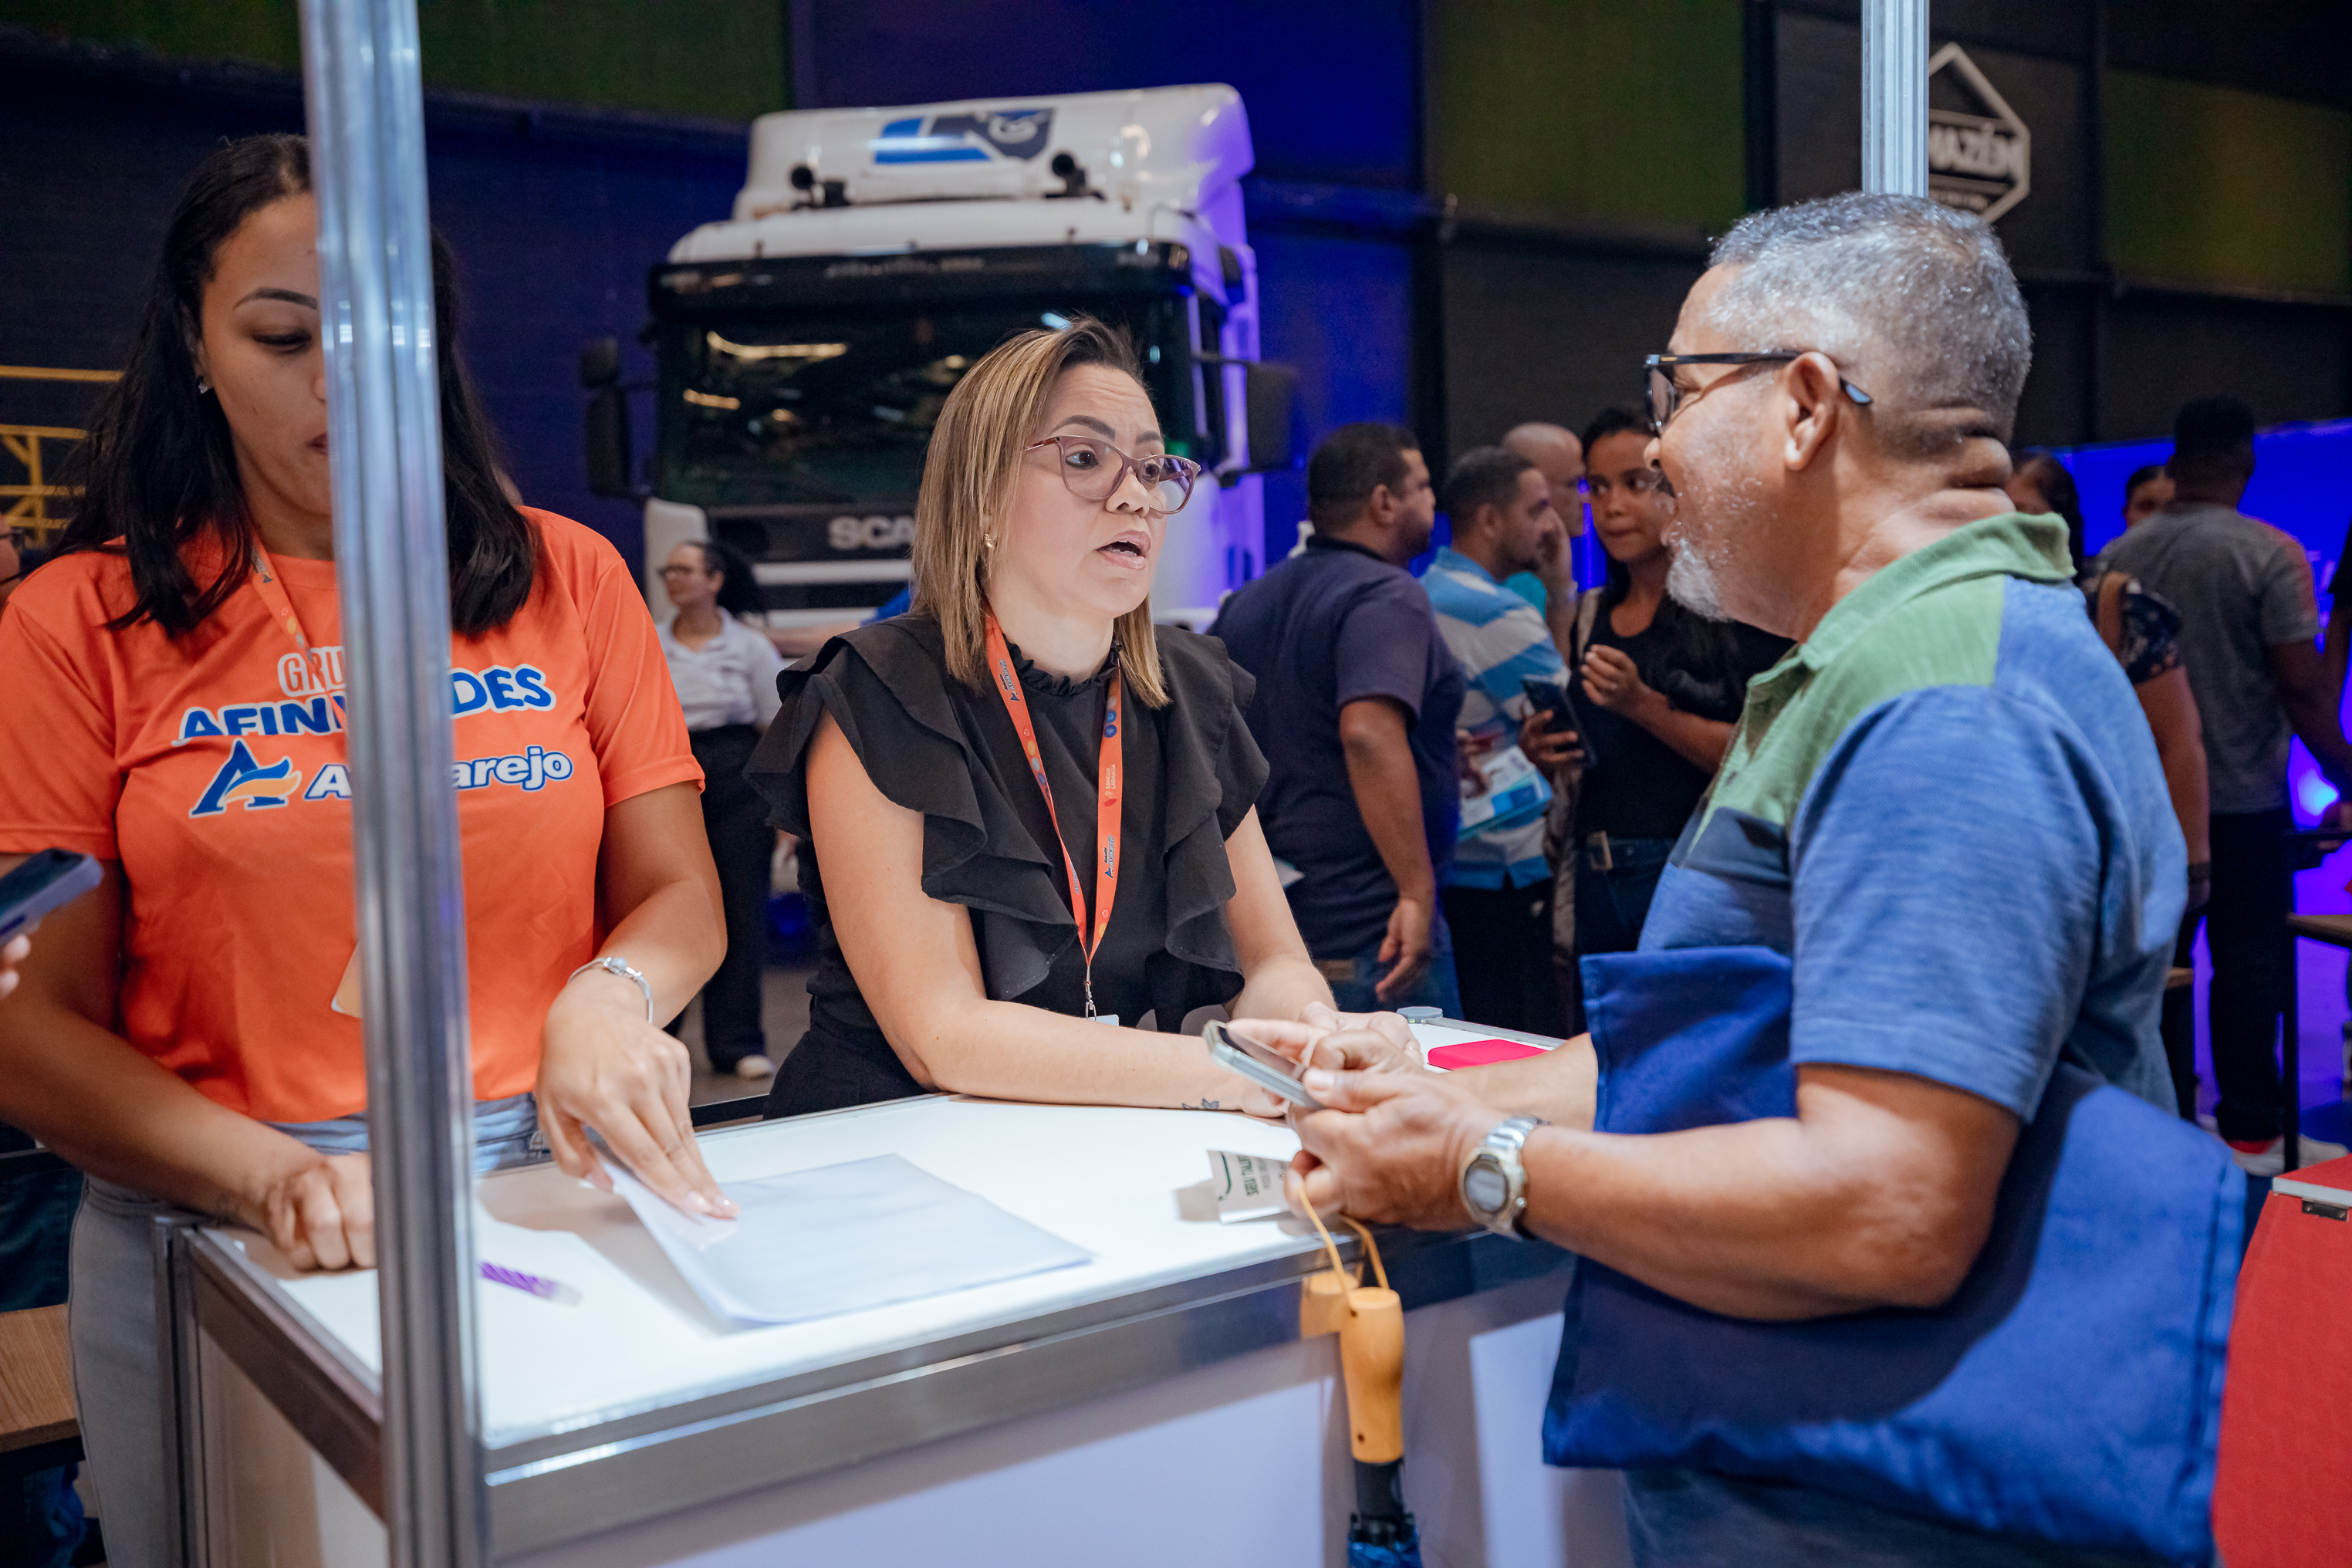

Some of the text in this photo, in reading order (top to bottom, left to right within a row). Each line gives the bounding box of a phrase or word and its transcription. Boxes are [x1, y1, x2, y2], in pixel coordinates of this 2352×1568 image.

[828, 515, 917, 549] SCA
[279, 648, 346, 696] GRU
[182, 666, 553, 739] AFINDES
[304, 745, 573, 801] Aarejo
